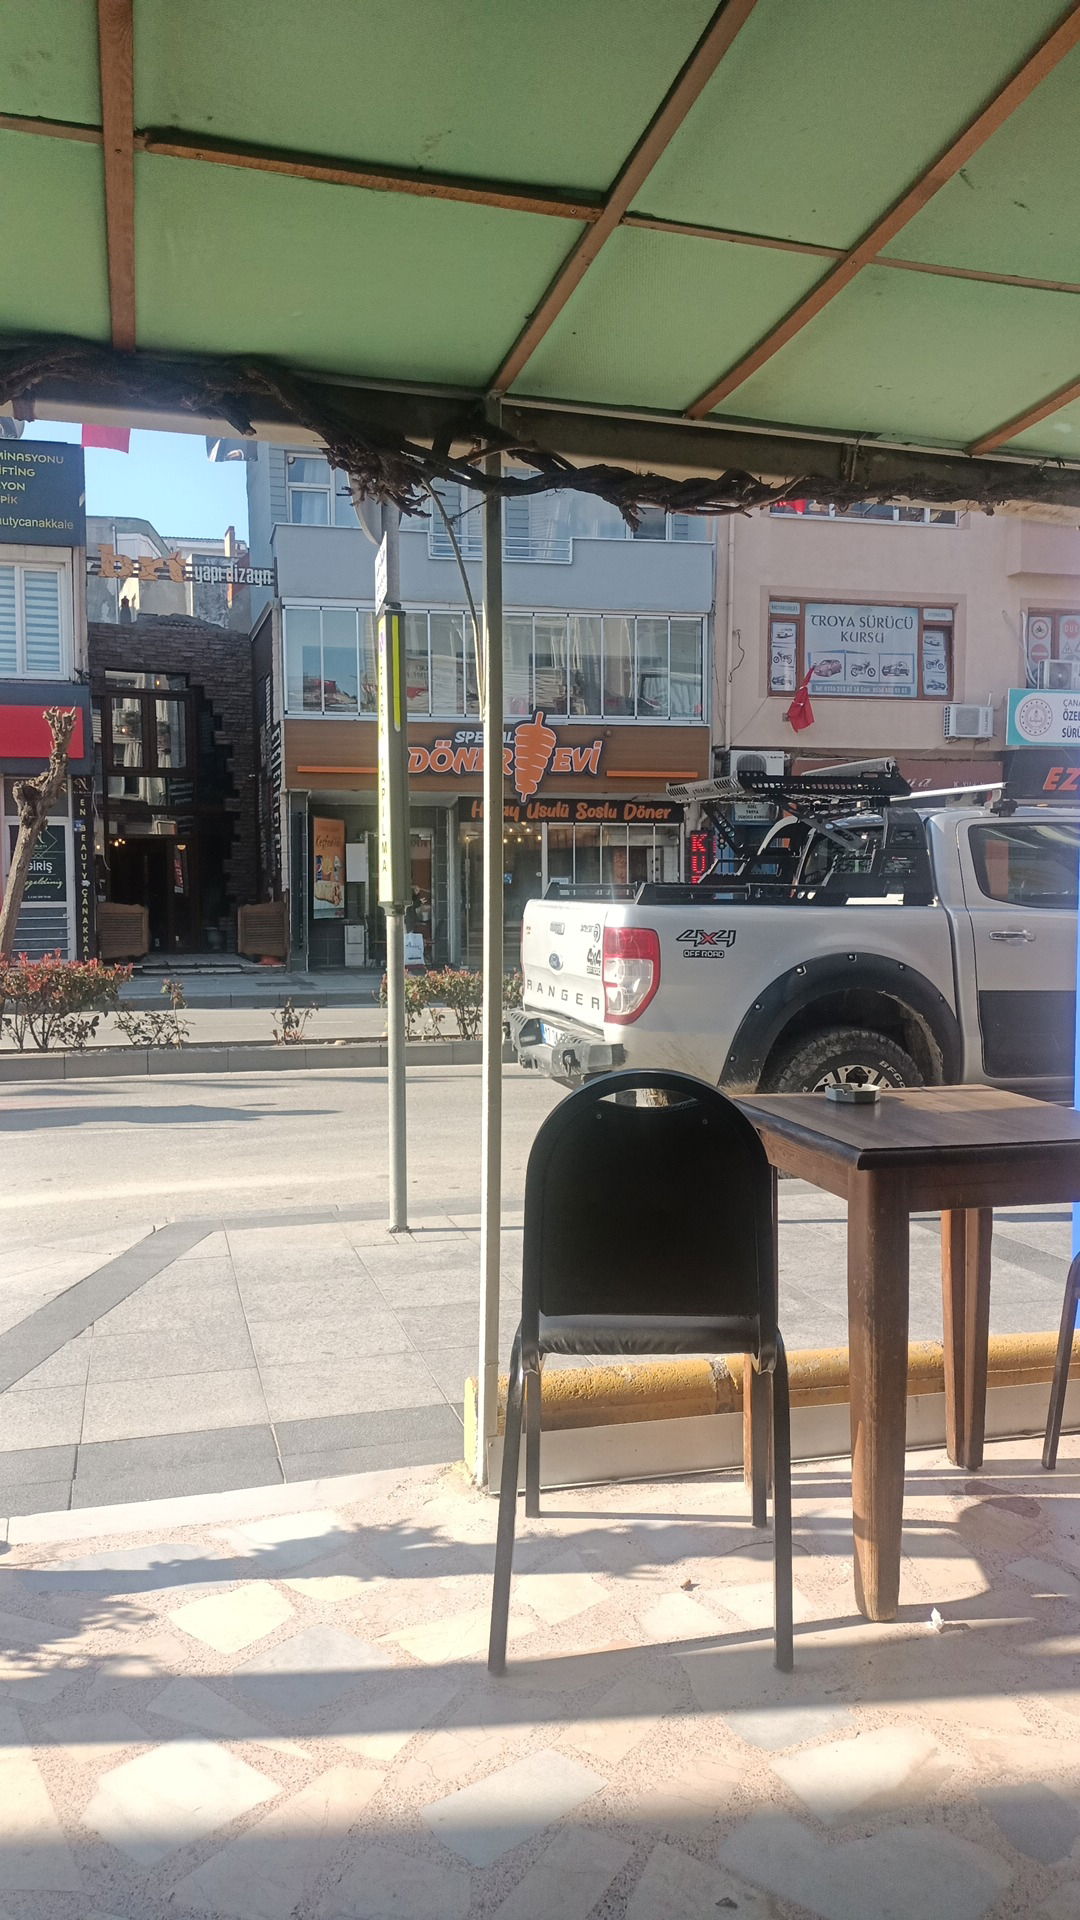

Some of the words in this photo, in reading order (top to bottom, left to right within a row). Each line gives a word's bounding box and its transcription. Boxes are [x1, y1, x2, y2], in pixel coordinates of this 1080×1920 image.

[0, 482, 26, 491] YON
[811, 614, 855, 628] TROYA
[859, 615, 914, 630] SÜRÜCÜ
[840, 631, 884, 643] KURSU
[1063, 699, 1080, 708] ÇAN
[455, 731, 516, 744] SPEL
[551, 740, 603, 775] EVİ
[471, 800, 519, 822] Hay
[526, 802, 569, 820] Usulü
[575, 802, 617, 820] Soslu
[623, 803, 671, 820] Döner
[684, 950, 700, 958] OFF
[701, 950, 725, 958] ROAD
[527, 979, 600, 1010] RANGER
